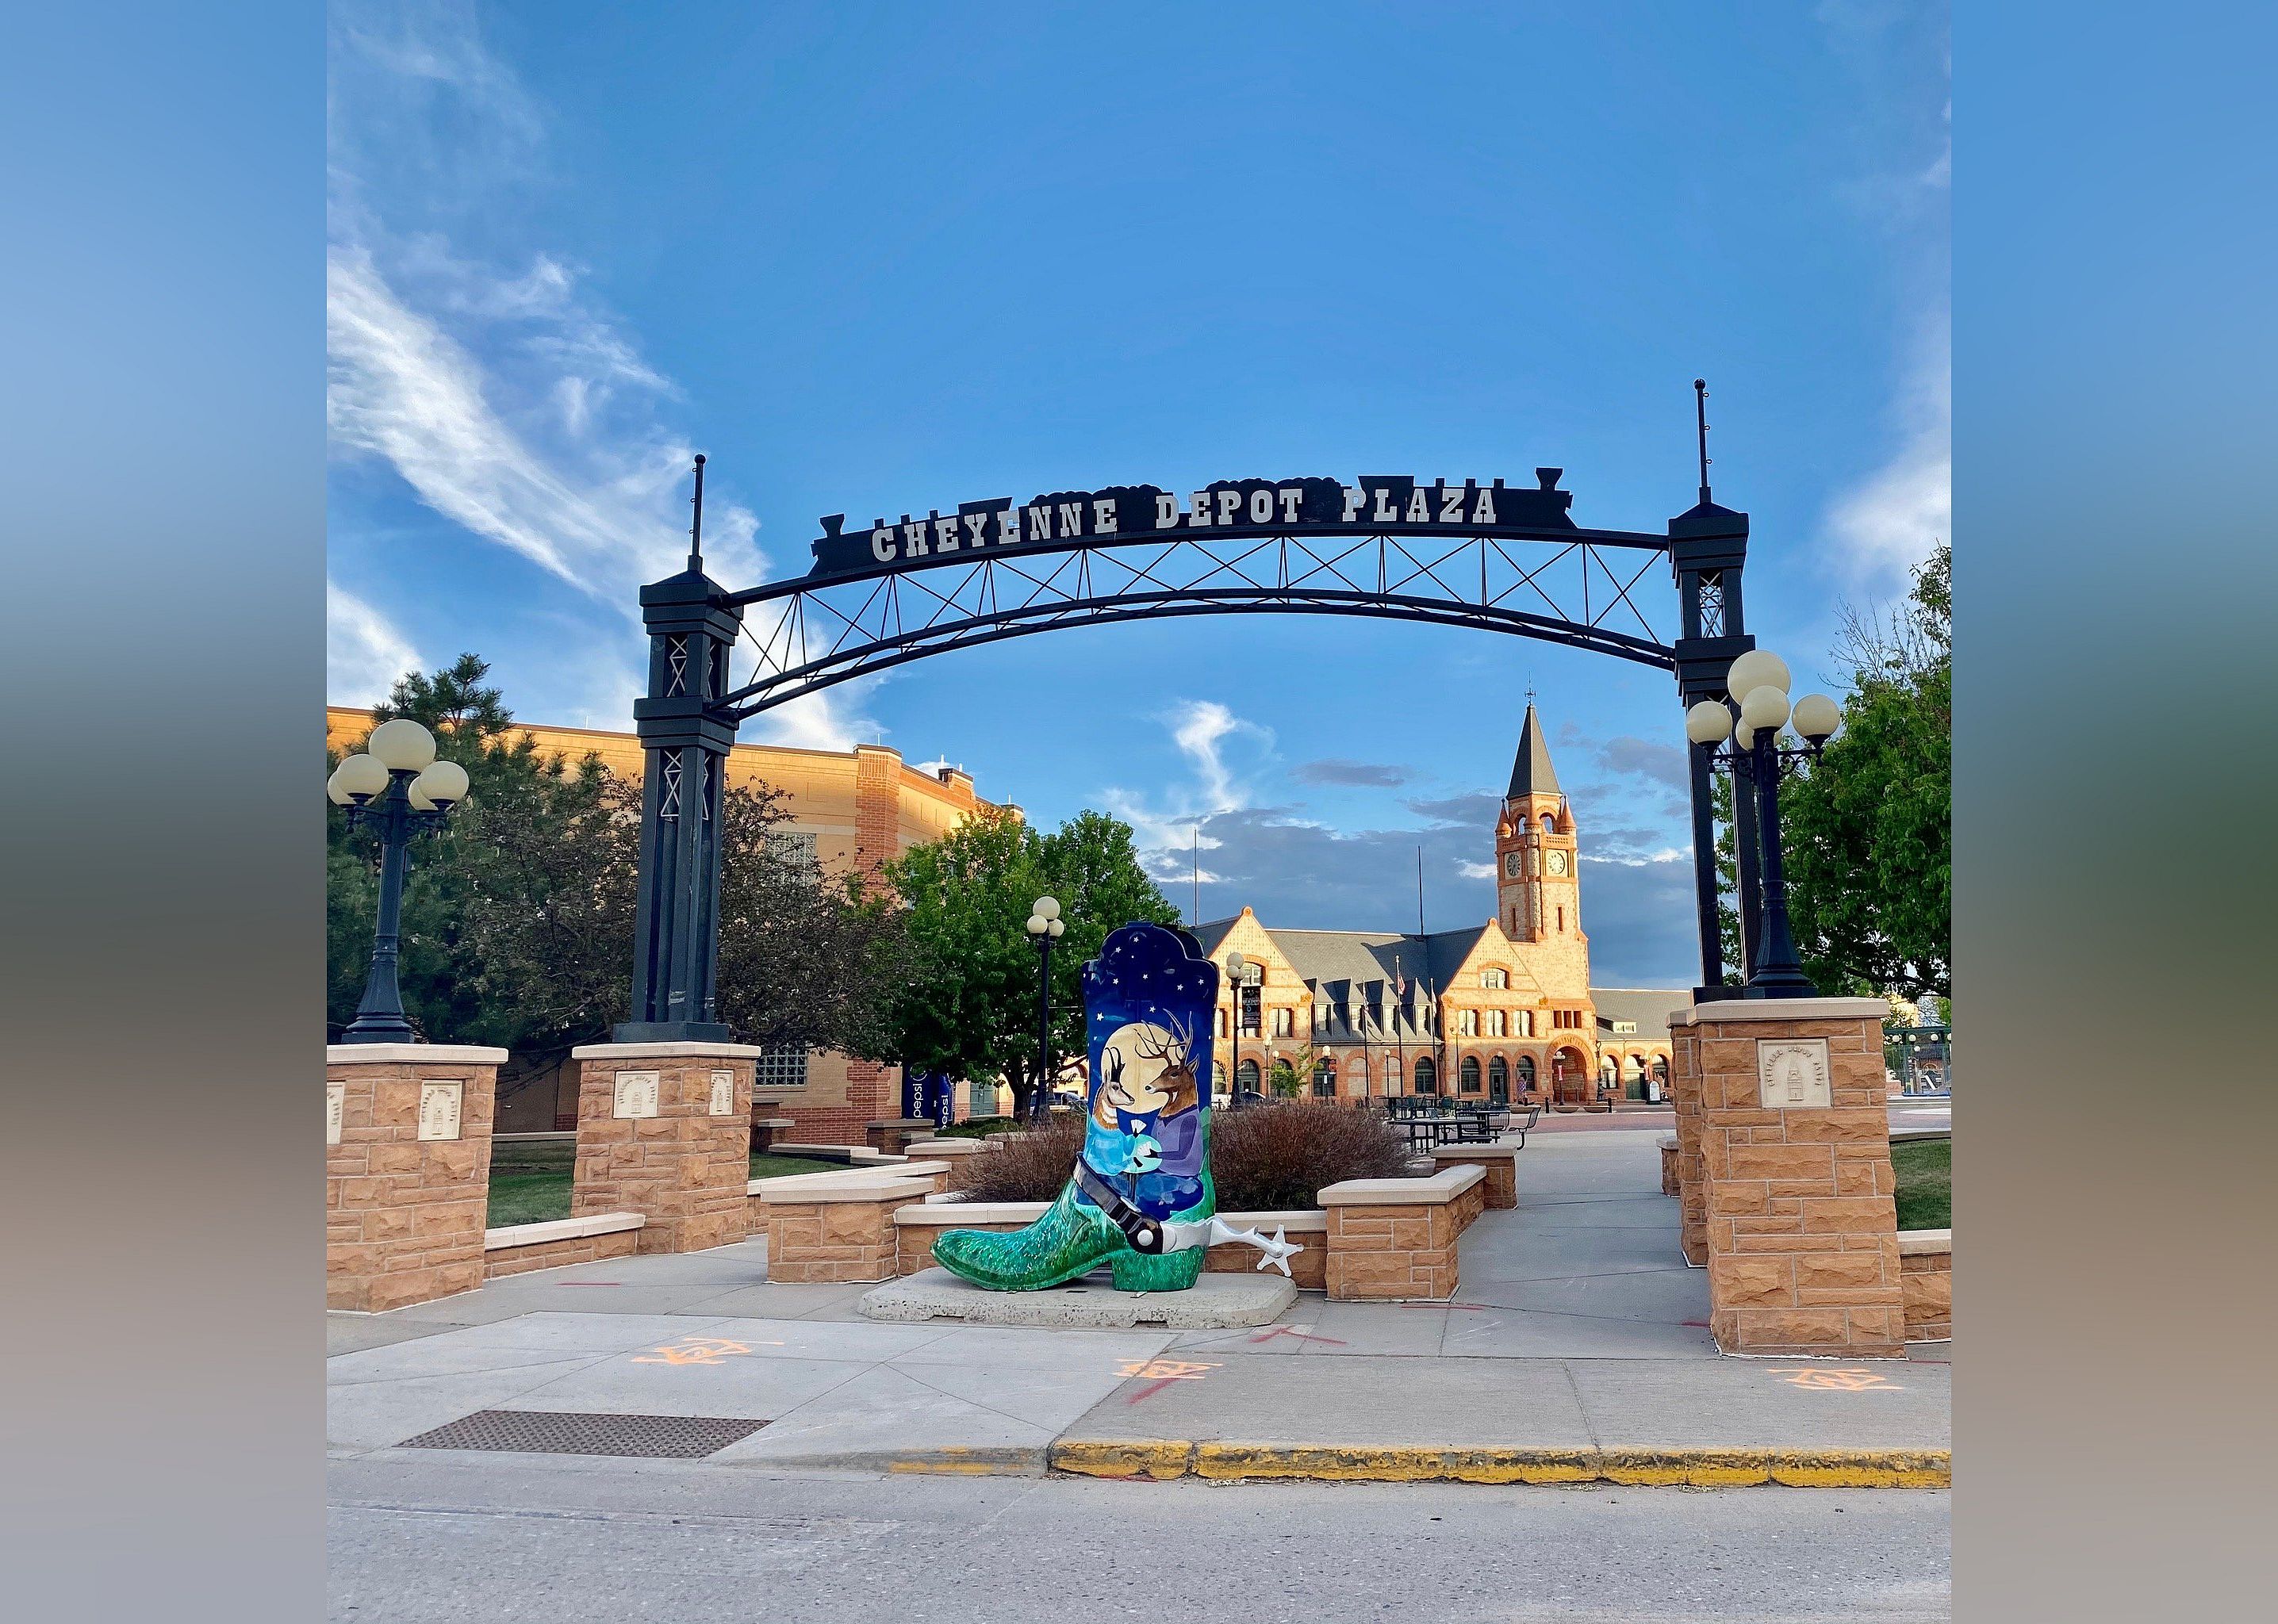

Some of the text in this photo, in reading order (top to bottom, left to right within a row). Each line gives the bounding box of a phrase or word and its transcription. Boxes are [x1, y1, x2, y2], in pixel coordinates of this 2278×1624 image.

[872, 488, 1497, 561] CHEYENNE DEPOT PLAZA
[913, 1083, 923, 1117] pepsi
